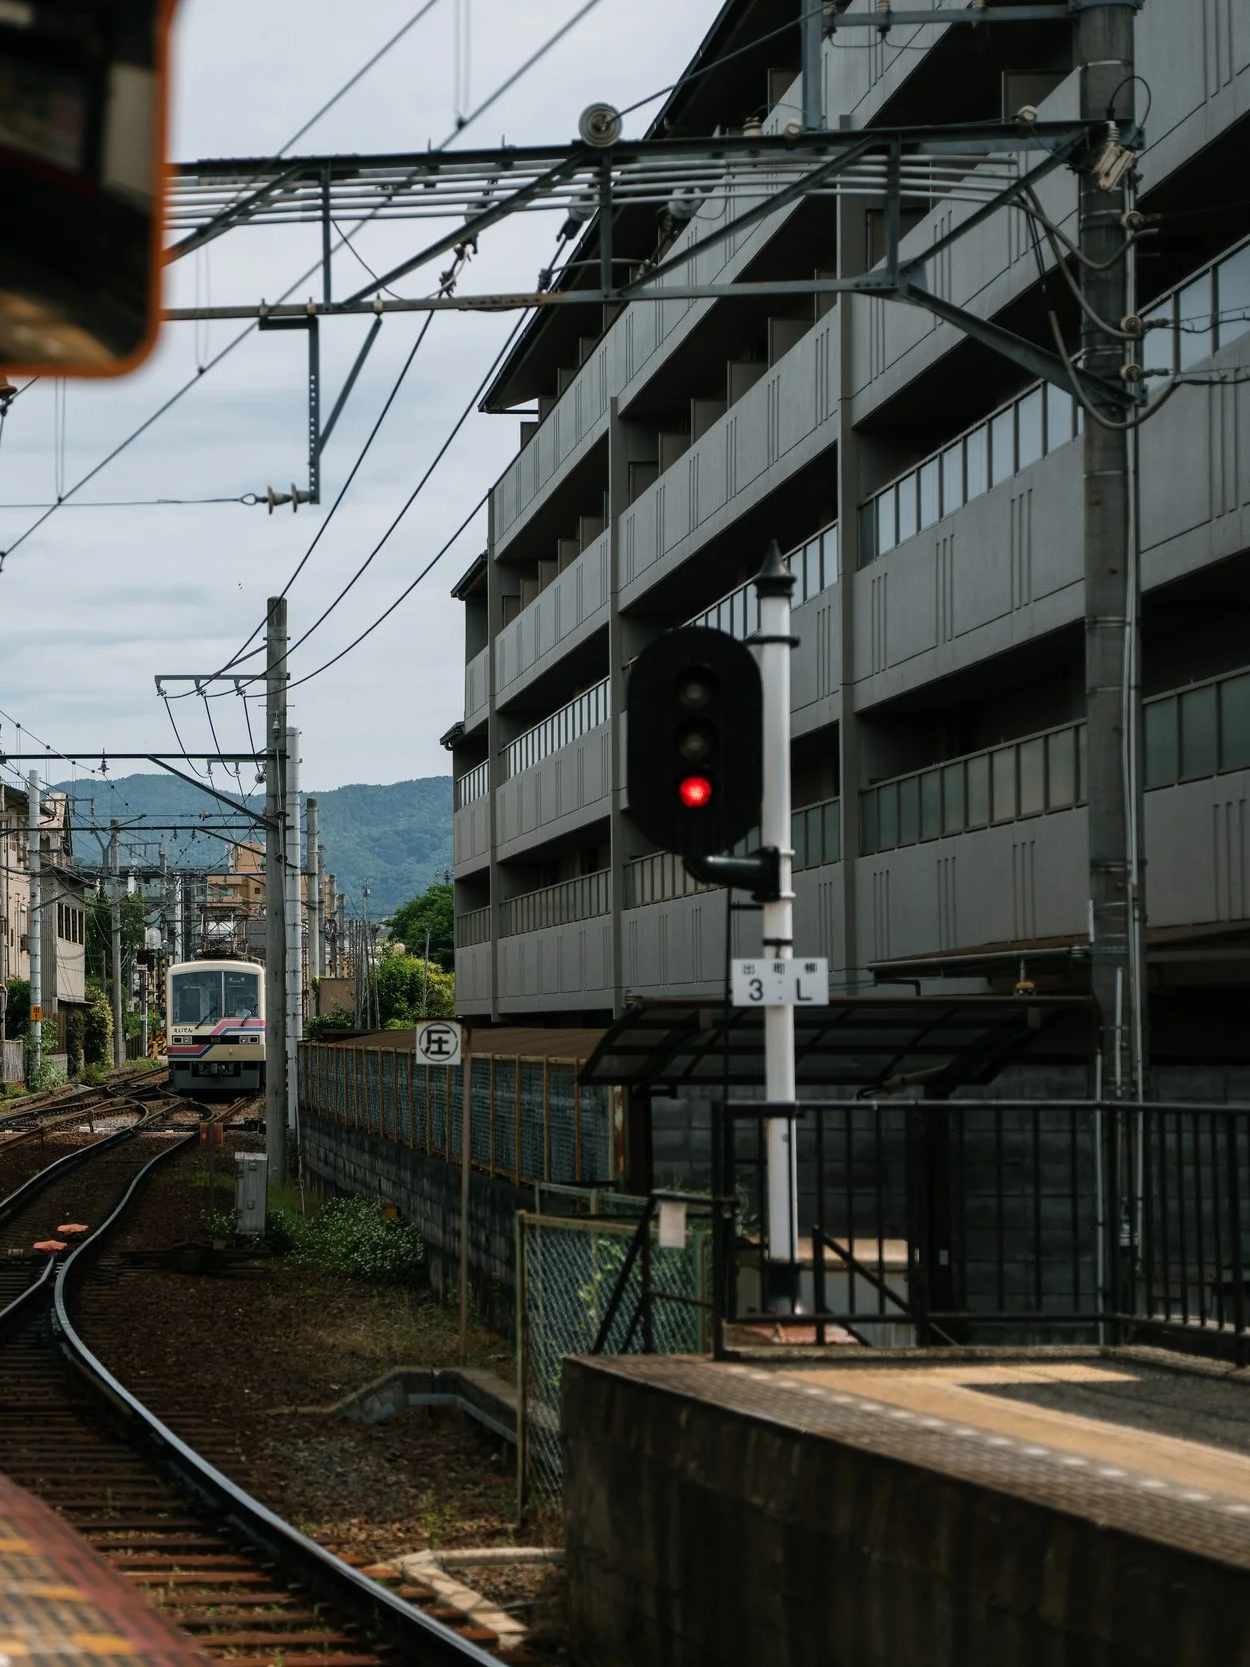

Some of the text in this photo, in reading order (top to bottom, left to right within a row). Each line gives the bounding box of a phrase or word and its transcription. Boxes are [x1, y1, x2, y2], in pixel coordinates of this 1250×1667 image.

[742, 963, 817, 975] 出町柳
[749, 978, 813, 1001] 3 L
[425, 1029, 451, 1055] 圧
